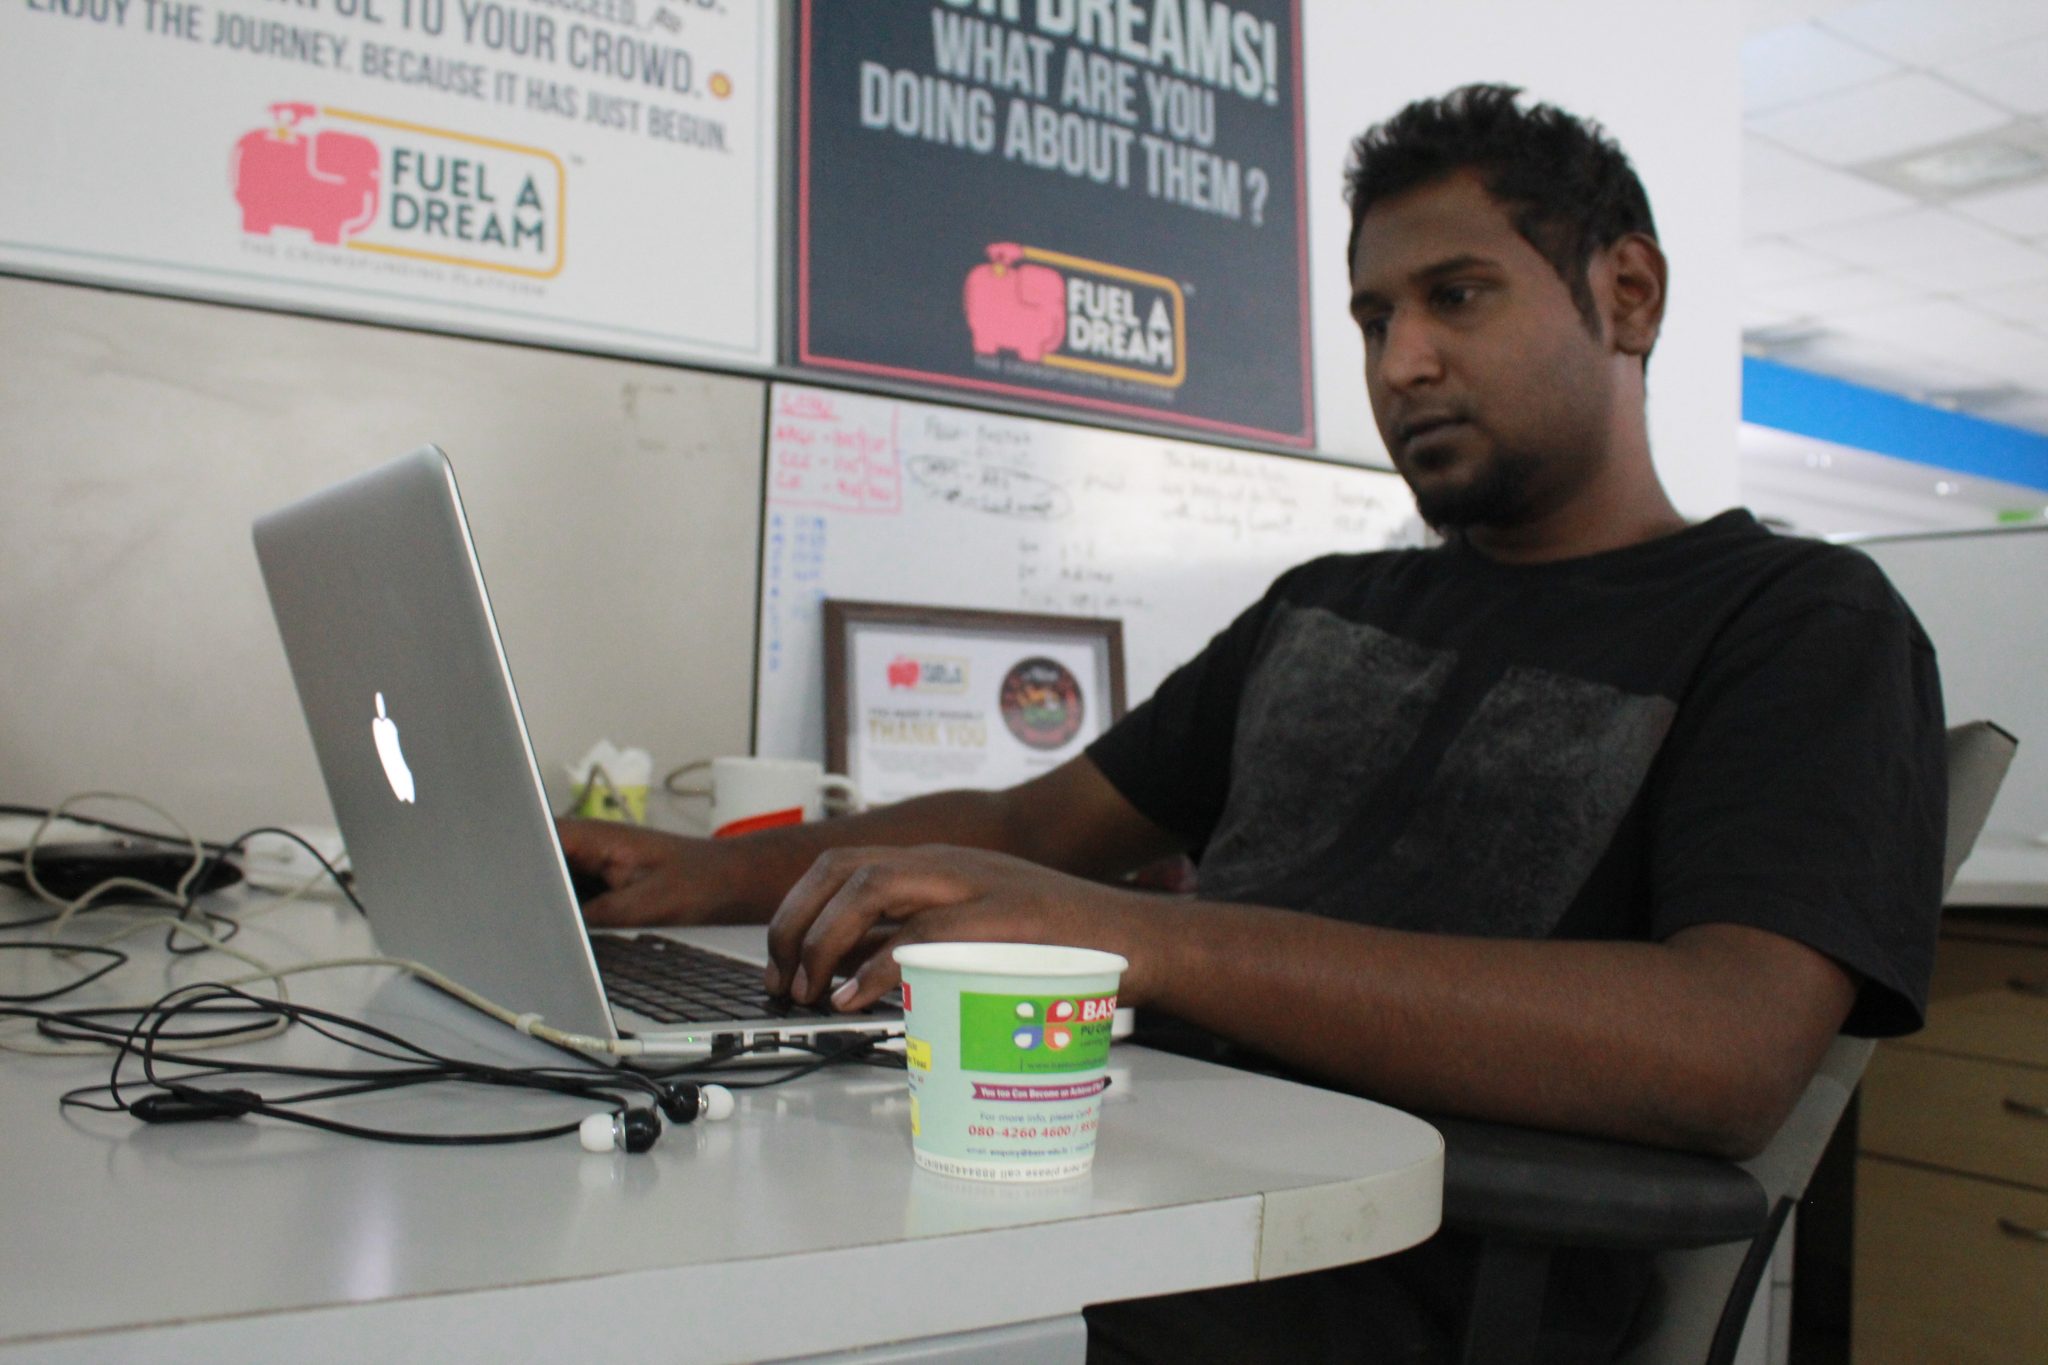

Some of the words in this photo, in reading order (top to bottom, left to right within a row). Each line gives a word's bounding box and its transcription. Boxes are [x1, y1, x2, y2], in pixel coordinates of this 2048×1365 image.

[145, 0, 201, 42] THE
[212, 9, 352, 72] JOURNEY.
[360, 42, 487, 99] BECAUSE
[496, 72, 520, 107] IT
[525, 79, 577, 120] HAS
[587, 95, 640, 131] JUST
[648, 106, 732, 154] BEGUN.
[459, 0, 556, 63] YOUR
[566, 24, 701, 98] CROWD.
[931, 8, 1055, 98] WHAT
[1061, 46, 1138, 125] ARE
[1145, 72, 1215, 147] YOU
[390, 146, 495, 203] FUEL
[516, 173, 543, 211] A
[860, 60, 996, 154] DOING
[1005, 98, 1134, 189] ABOUT
[1142, 134, 1242, 221] THEM
[389, 191, 545, 253] DREAM
[1067, 276, 1142, 328] FUEL
[1147, 296, 1173, 331] A
[1067, 314, 1174, 369] DREAM
